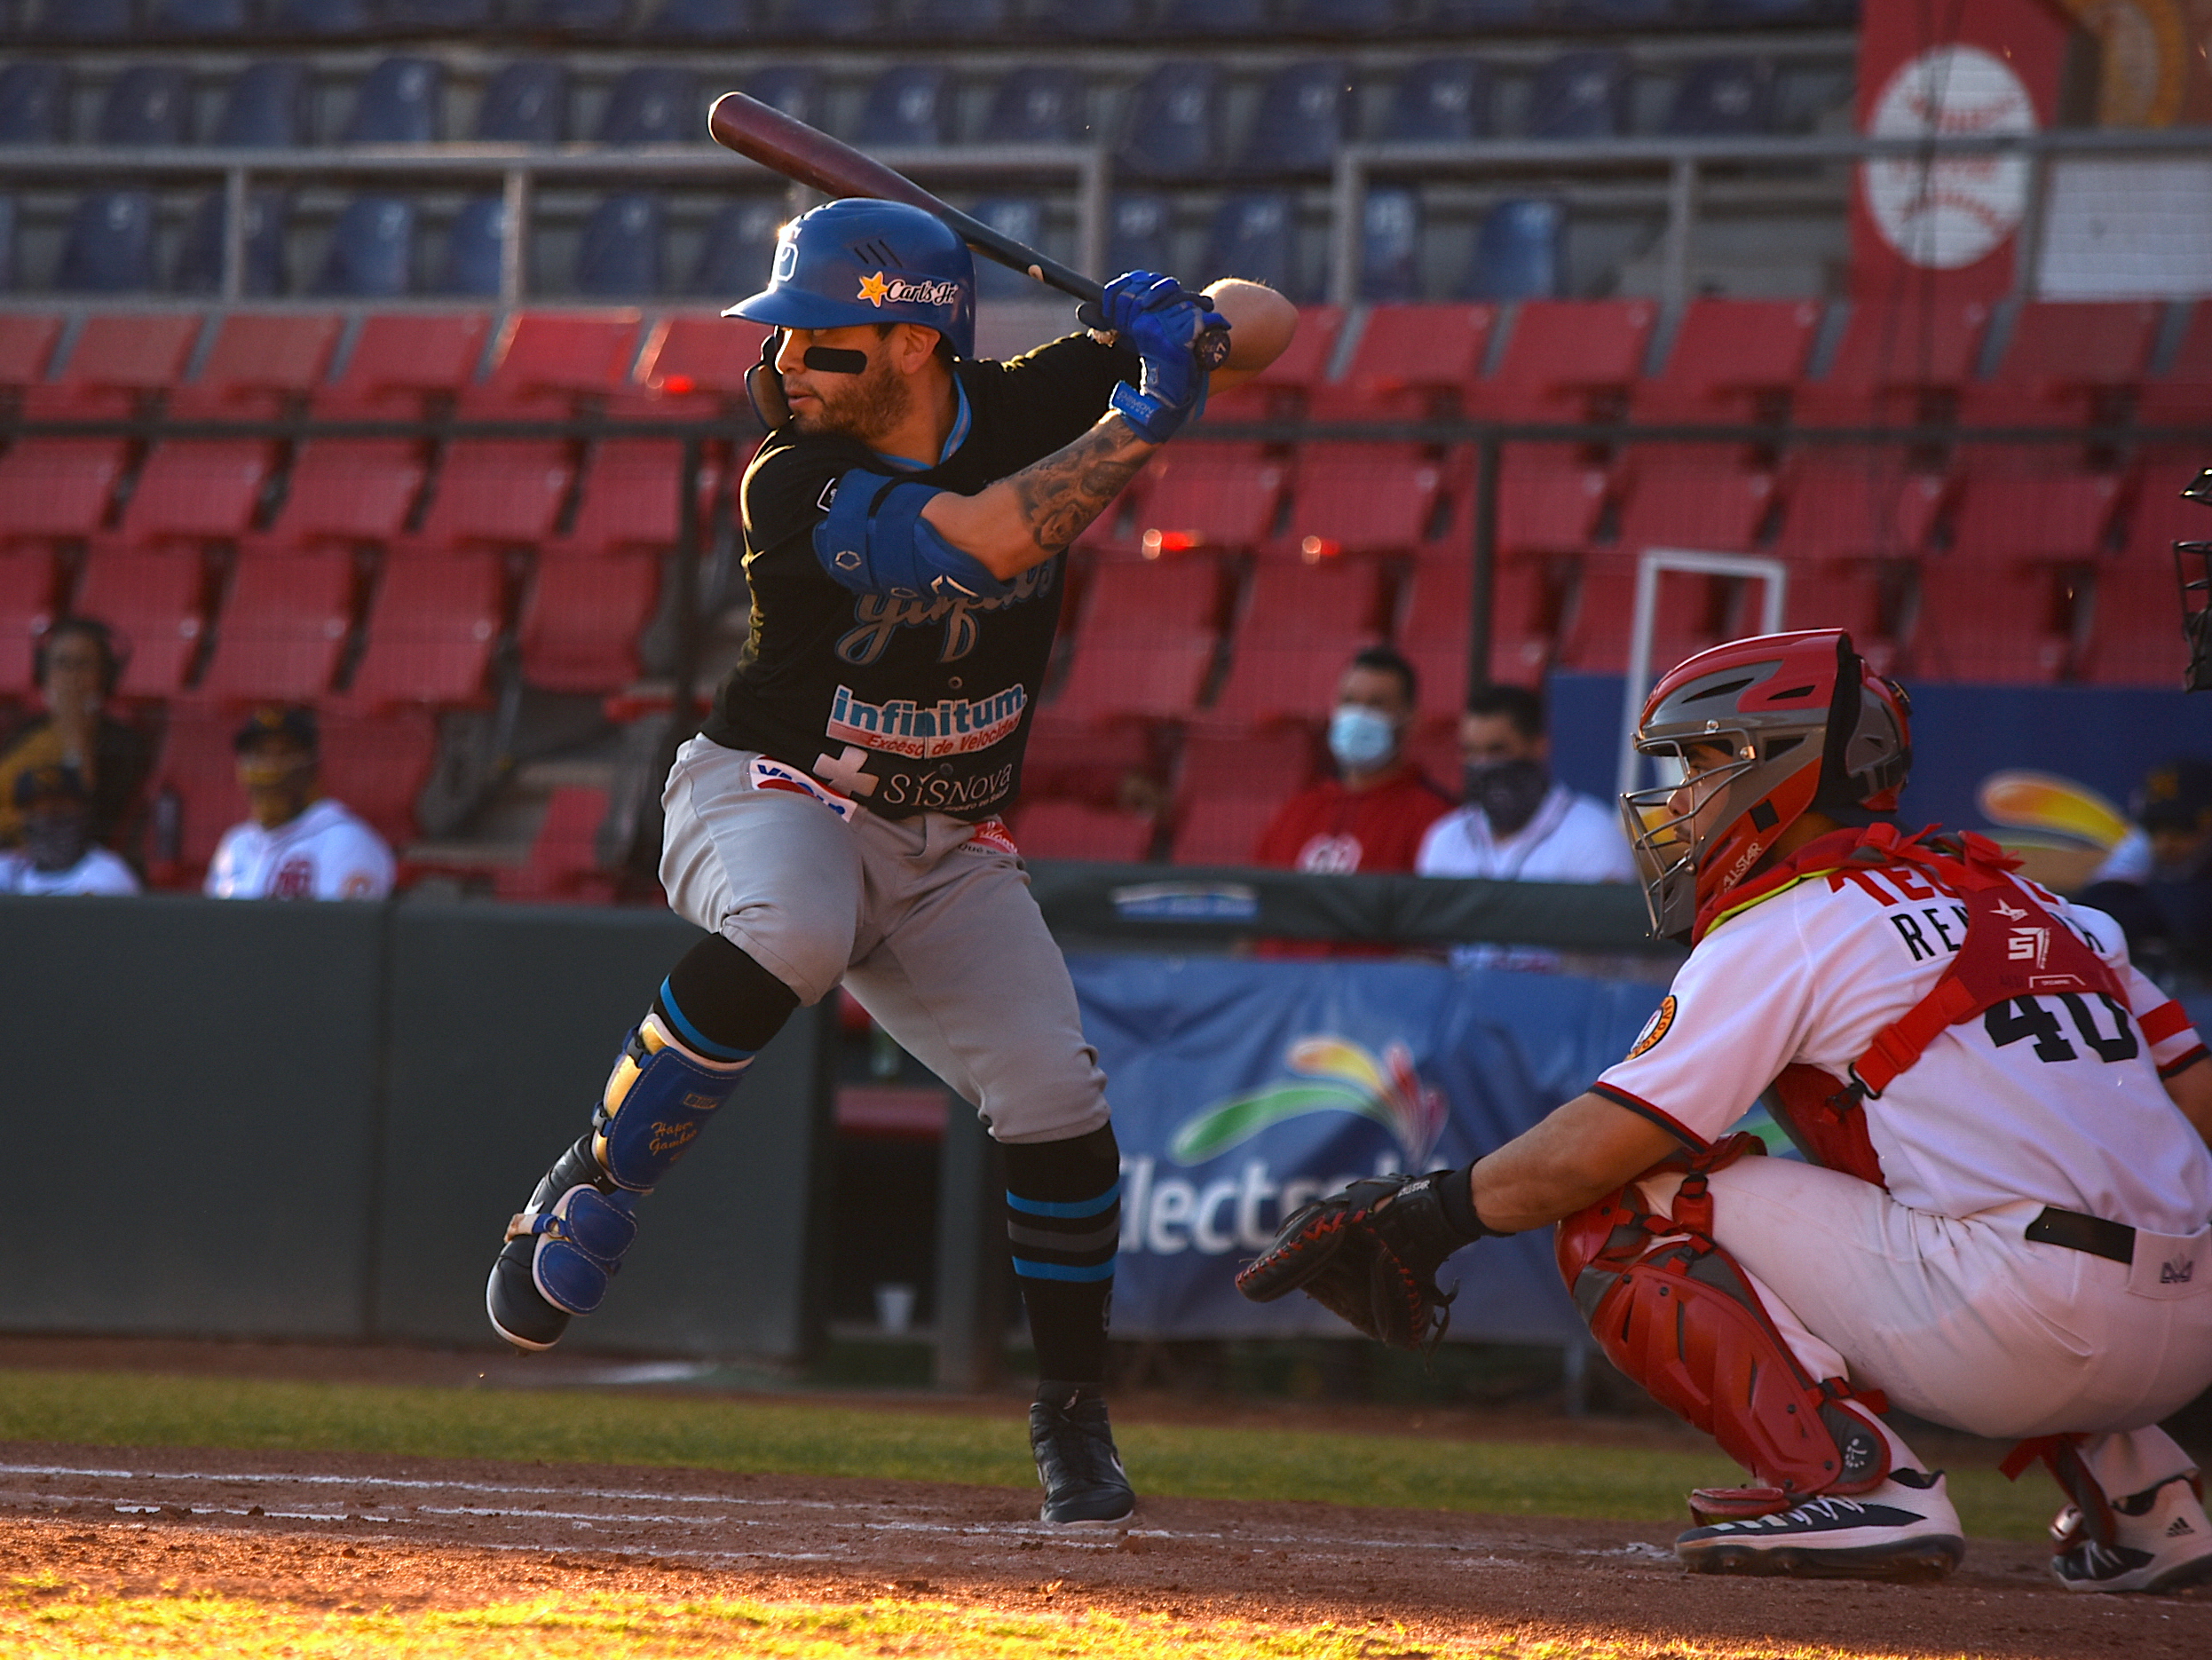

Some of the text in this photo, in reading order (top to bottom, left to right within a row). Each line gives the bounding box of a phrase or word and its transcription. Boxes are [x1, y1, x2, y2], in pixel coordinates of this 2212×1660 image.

[888, 280, 934, 303] Carl's
[832, 686, 1023, 739] infinitum
[866, 735, 925, 757] Exceso
[932, 739, 955, 755] de
[1984, 991, 2138, 1063] 40
